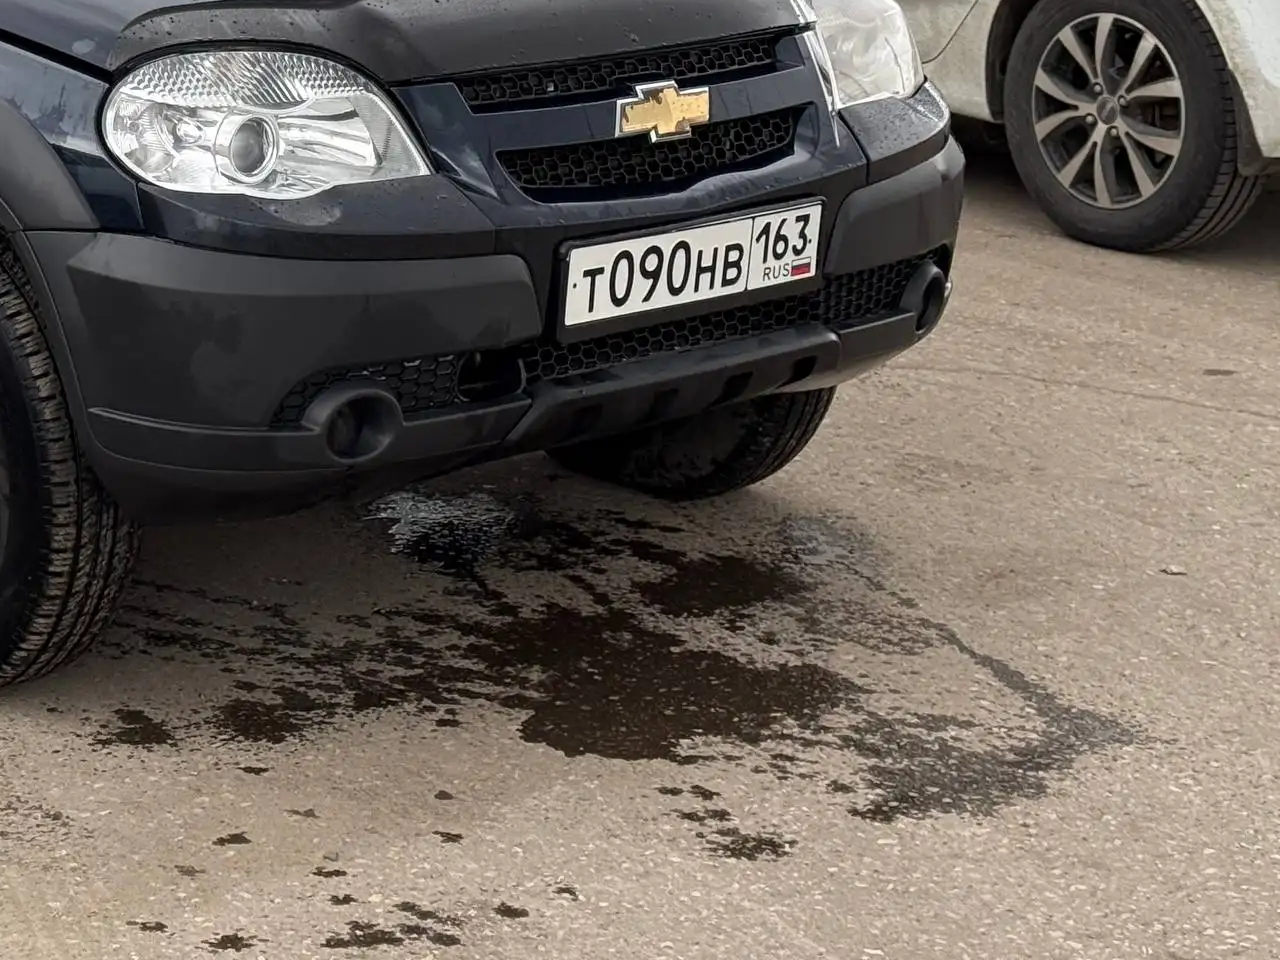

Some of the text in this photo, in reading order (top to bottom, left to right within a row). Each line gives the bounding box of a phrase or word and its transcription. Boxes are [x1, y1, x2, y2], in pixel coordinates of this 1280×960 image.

[582, 213, 811, 313] Т090НВ 163
[763, 262, 790, 282] RUS
